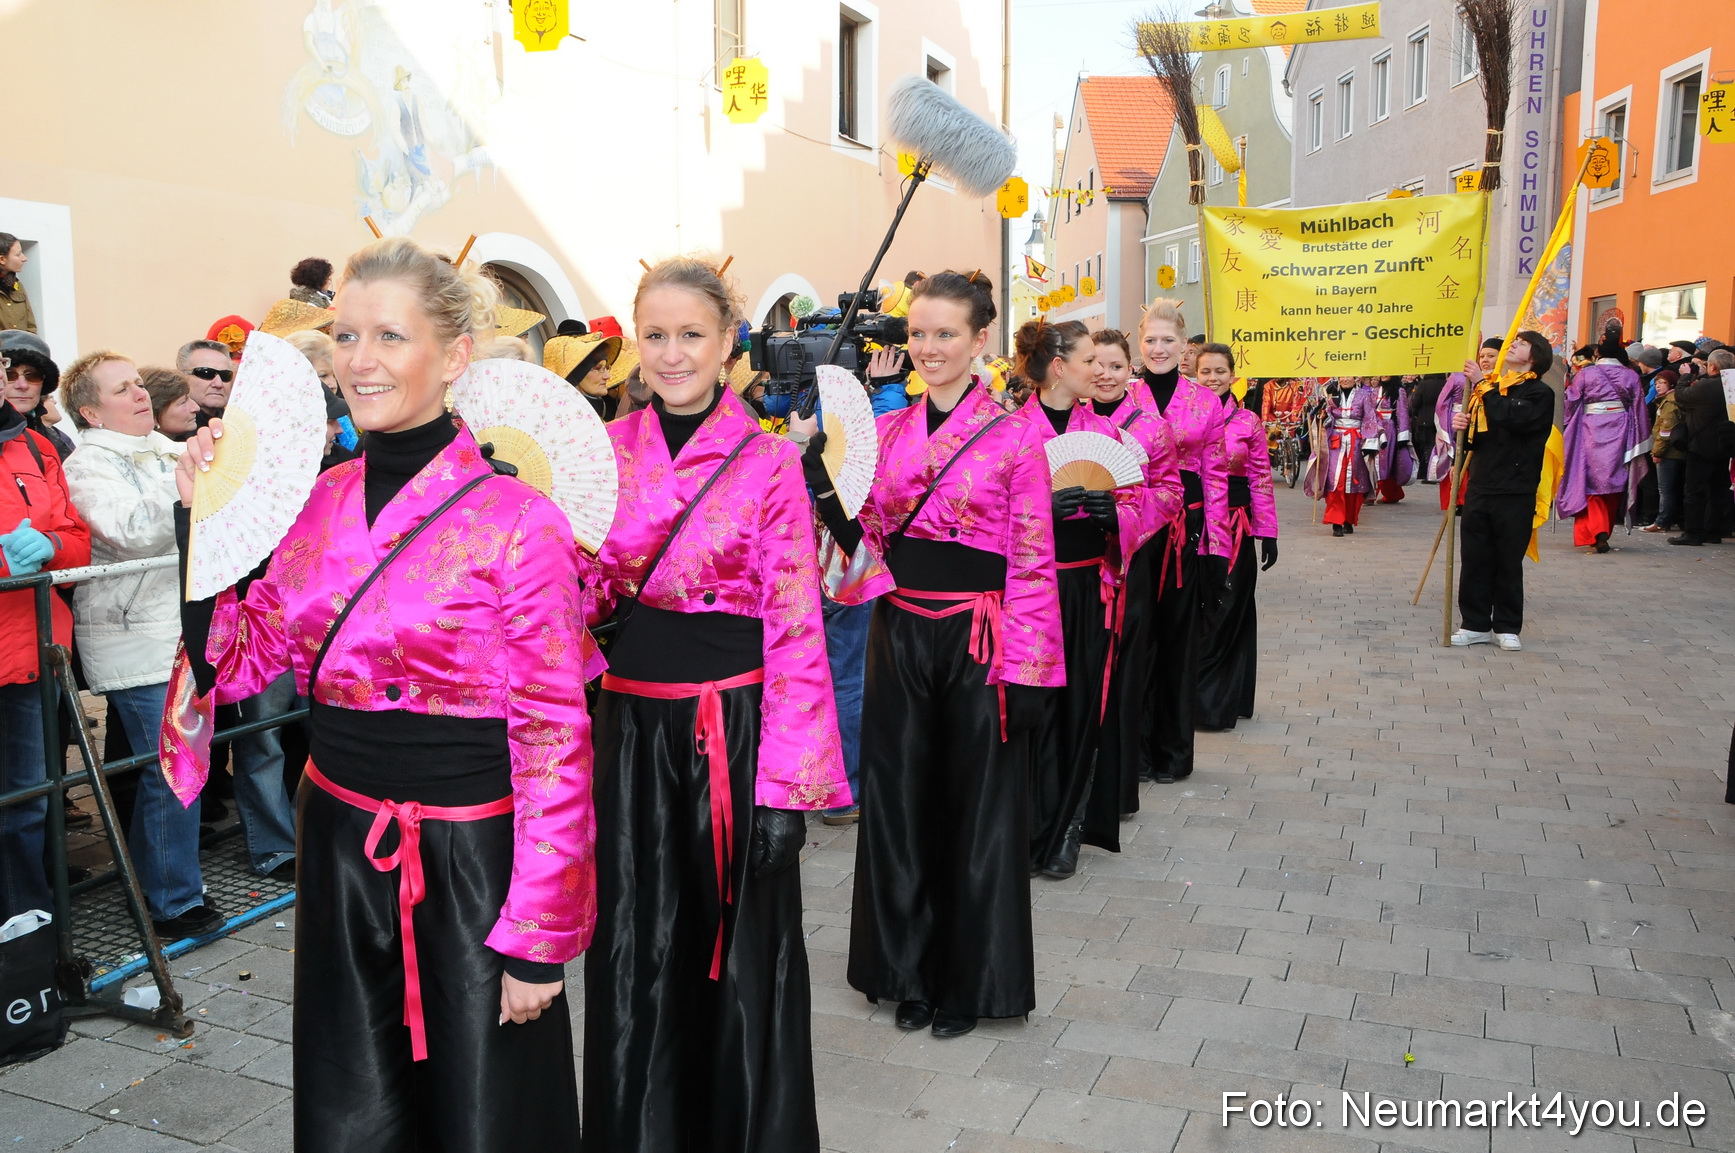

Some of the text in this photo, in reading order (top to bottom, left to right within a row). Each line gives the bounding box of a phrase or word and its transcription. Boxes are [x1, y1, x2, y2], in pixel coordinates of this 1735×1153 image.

[1527, 10, 1547, 114] UHREN
[1518, 130, 1539, 275] SCHMUCK
[1223, 213, 1246, 236] 家
[1300, 212, 1395, 235] Mühlbach
[1416, 210, 1442, 235] 河
[1302, 239, 1394, 253] Brutstätte der
[1315, 285, 1377, 298] in Bayern
[1436, 275, 1460, 300] 金
[1281, 302, 1414, 316] kann heuer 40 Jahre
[1231, 327, 1346, 342] Kaminkehrer
[1365, 323, 1464, 340] Geschichte
[1294, 347, 1318, 370] 火
[1325, 351, 1367, 361] feiern!
